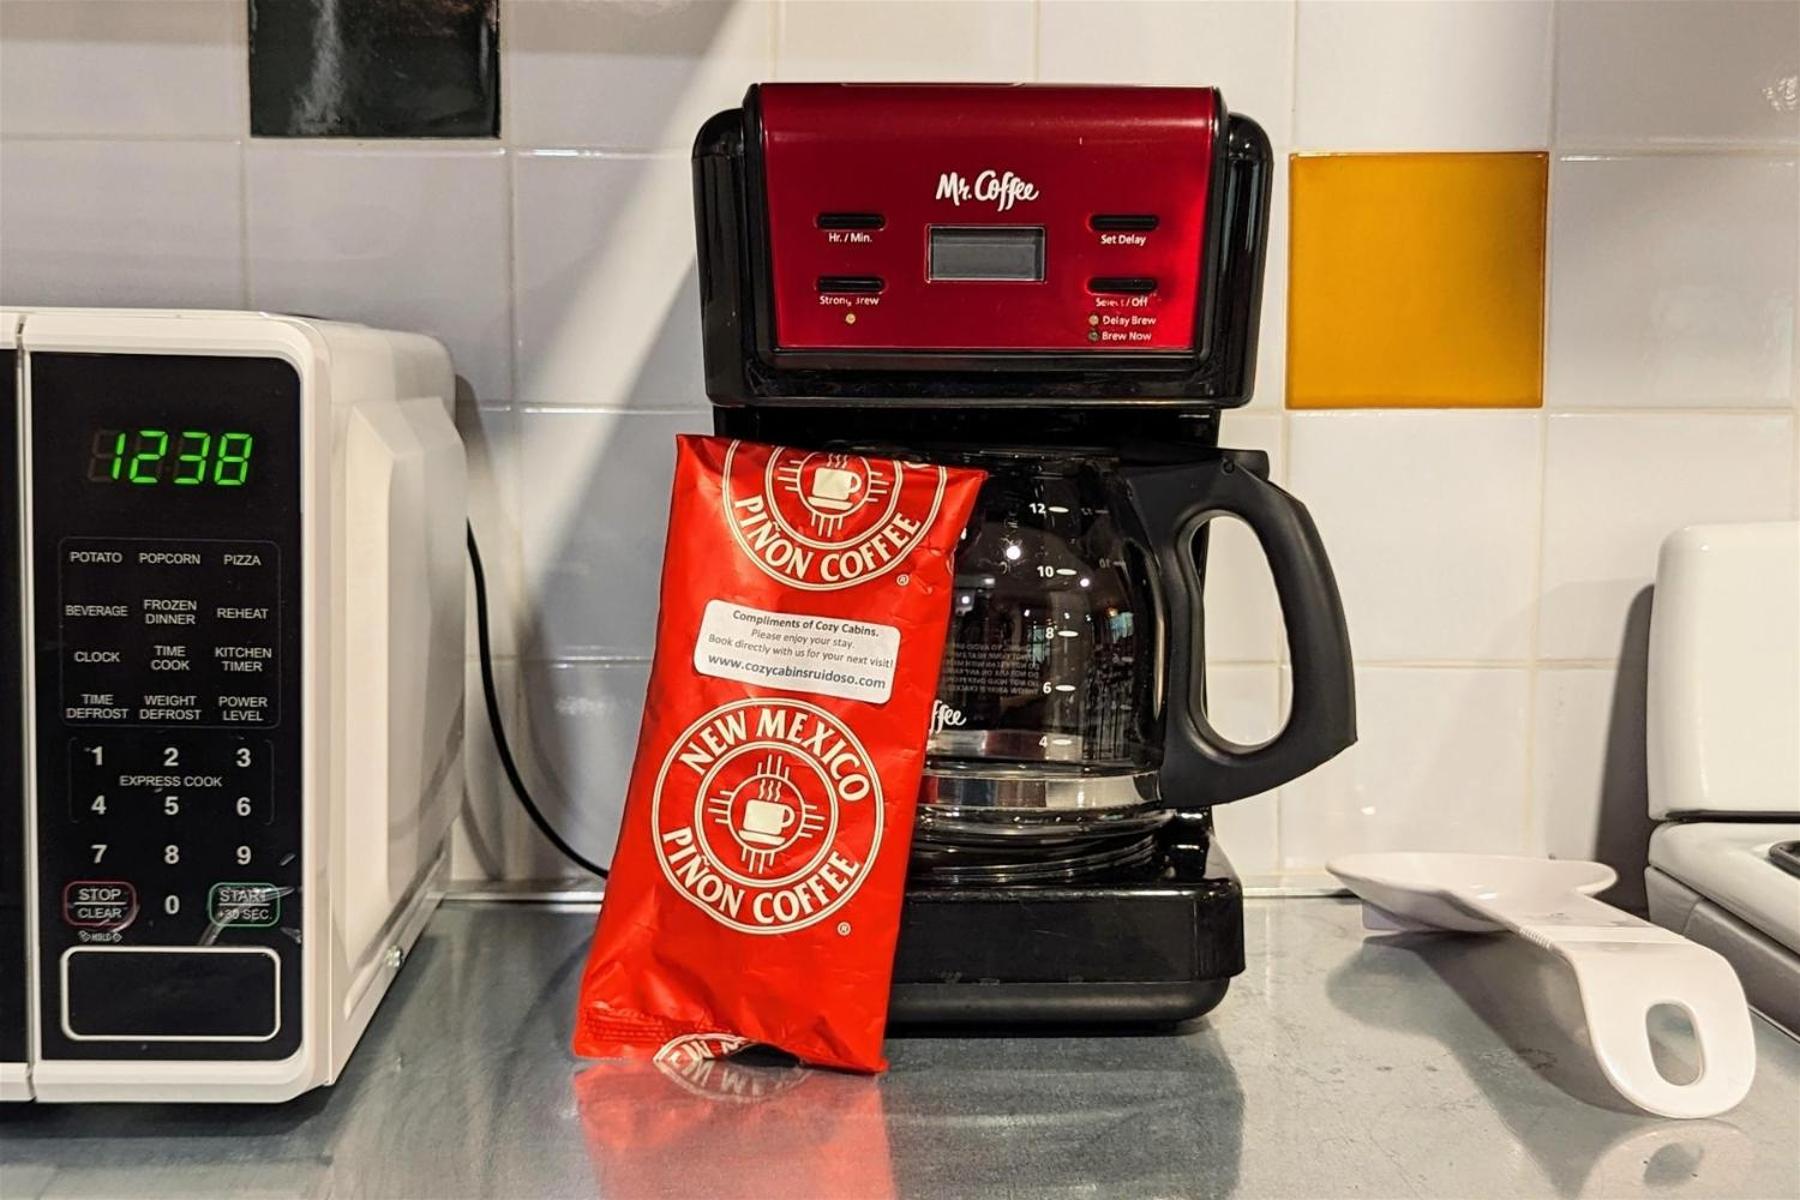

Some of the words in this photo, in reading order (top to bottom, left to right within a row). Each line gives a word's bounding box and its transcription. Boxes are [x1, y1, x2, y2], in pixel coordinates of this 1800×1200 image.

[935, 171, 973, 206] Mr.
[974, 169, 1040, 212] Coffee
[828, 232, 843, 243] Hr.
[850, 232, 873, 243] Min.
[1100, 234, 1117, 245] Set
[1118, 234, 1147, 247] Delay
[1131, 296, 1148, 307] Off
[1102, 315, 1130, 328] Delay
[1131, 315, 1157, 325] Brew
[1101, 331, 1127, 341] Brew
[1129, 331, 1152, 341] Now
[111, 430, 253, 486] 1238
[1029, 502, 1046, 516] 12
[734, 494, 813, 580] PIÑON
[820, 511, 922, 583] COFFEE
[69, 551, 123, 564] POTATO
[139, 552, 201, 565] POPCORN
[223, 553, 262, 566] PIZZA
[1036, 565, 1055, 578] 10
[65, 604, 128, 617] BEVERAGE
[143, 599, 197, 611] FROZEN
[145, 613, 196, 625] DINNER
[216, 607, 269, 620] REHEAT
[732, 610, 800, 629] Compliments
[802, 618, 814, 630] of
[815, 621, 840, 634] Cozy
[841, 623, 879, 637] Cabins.
[751, 629, 781, 641] Please
[783, 633, 808, 645] enjoy
[810, 635, 831, 646] your
[832, 638, 855, 650] stay.
[1045, 627, 1055, 640] 8
[73, 651, 121, 663] CLOCK
[154, 644, 186, 657] TIME
[214, 646, 272, 659] KITCHEN
[708, 633, 733, 647] Book
[734, 638, 771, 655] directly
[772, 643, 793, 657] with
[795, 649, 805, 657] us
[805, 649, 821, 659] for
[822, 651, 844, 663] your
[846, 655, 868, 666] next
[869, 656, 894, 669] visit!
[150, 659, 190, 671] COOK
[221, 660, 263, 672] TIMER
[707, 653, 887, 689] www.cozycabinsruidoso.com
[1042, 681, 1052, 694] 6
[81, 693, 114, 706] TIME
[143, 694, 197, 707] WEIGHT
[218, 695, 268, 708] POWER
[66, 707, 129, 720] DEFROST
[139, 708, 202, 721] DEFROST
[222, 709, 264, 722] LEVEL
[929, 699, 967, 735] ffee
[1038, 735, 1049, 748] 4
[91, 746, 103, 766] 1
[163, 747, 180, 767] 2
[236, 748, 252, 768] 3
[678, 709, 748, 776] NEW
[755, 707, 871, 802] MEXICO
[119, 775, 181, 787] EXPRESS
[183, 776, 223, 788] COOK
[91, 795, 107, 815] 4
[164, 796, 180, 816] 5
[236, 797, 252, 817] 6
[91, 844, 108, 864] 7
[164, 845, 180, 865] 8
[236, 845, 252, 865] 9
[662, 826, 746, 919] PIÑON
[752, 850, 862, 924] COFFEE
[78, 888, 122, 901] STOP
[164, 894, 180, 915] 0
[77, 907, 122, 919] CLEAR
[242, 908, 273, 920] SEC.
